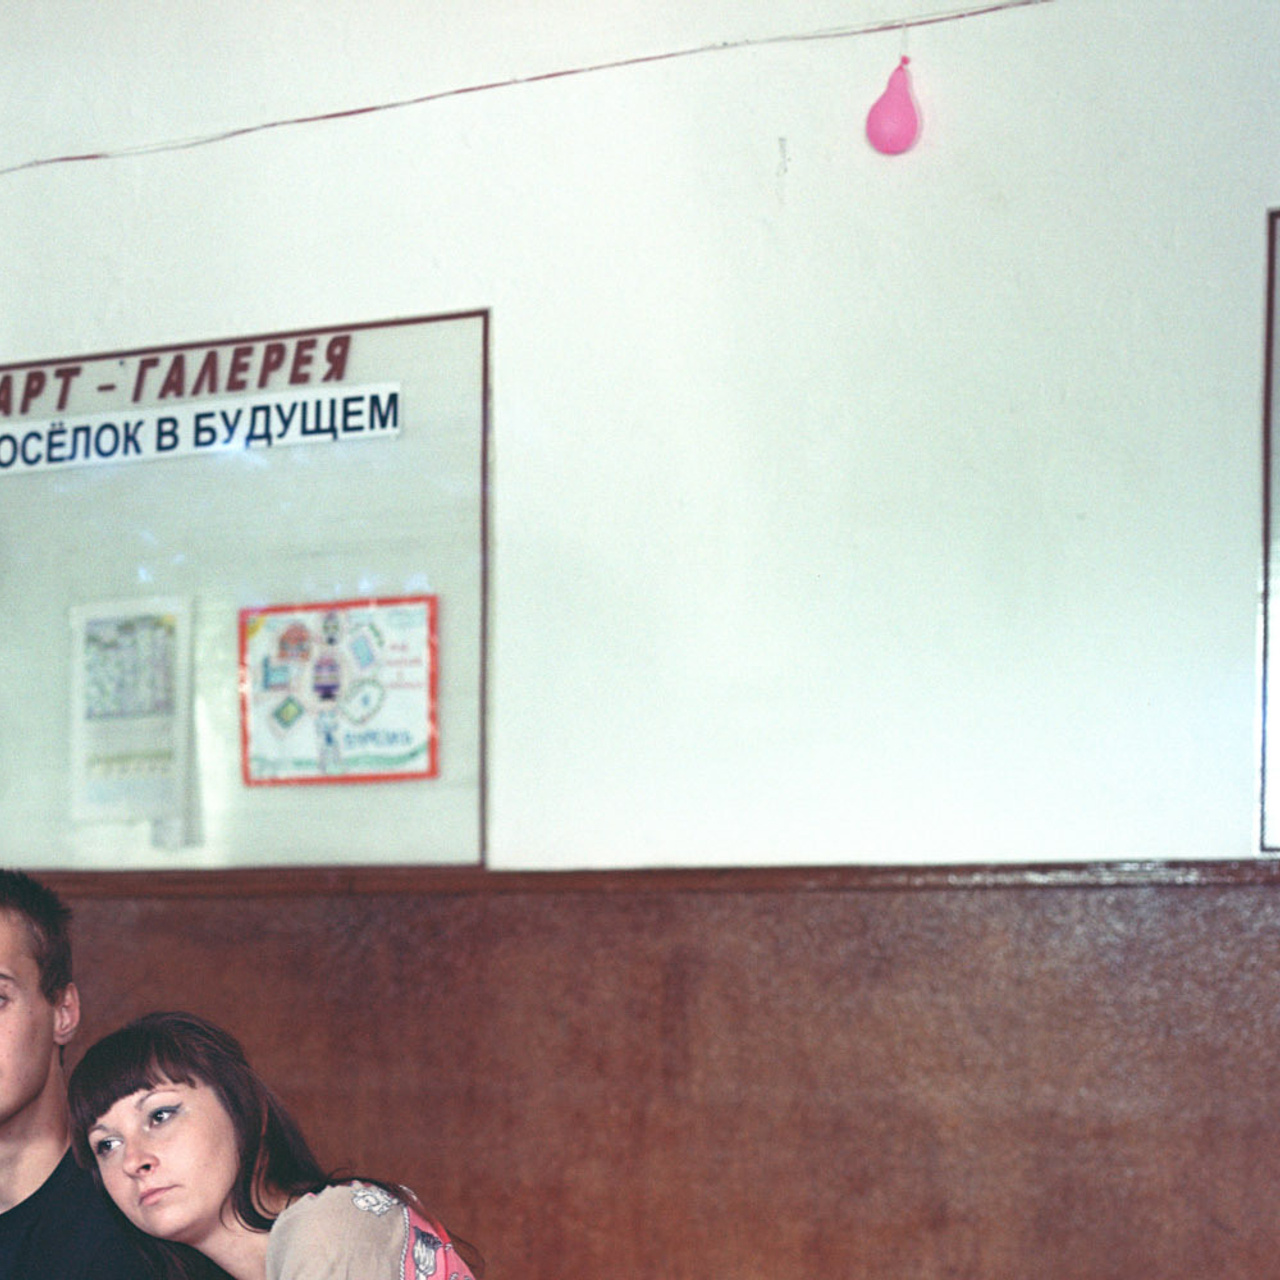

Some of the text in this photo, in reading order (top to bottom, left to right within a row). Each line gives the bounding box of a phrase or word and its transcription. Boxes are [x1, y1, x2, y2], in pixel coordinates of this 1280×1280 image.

[132, 335, 351, 402] ГАЛЕРЕЯ
[155, 416, 180, 452] В
[193, 392, 399, 448] БУДУЩЕМ
